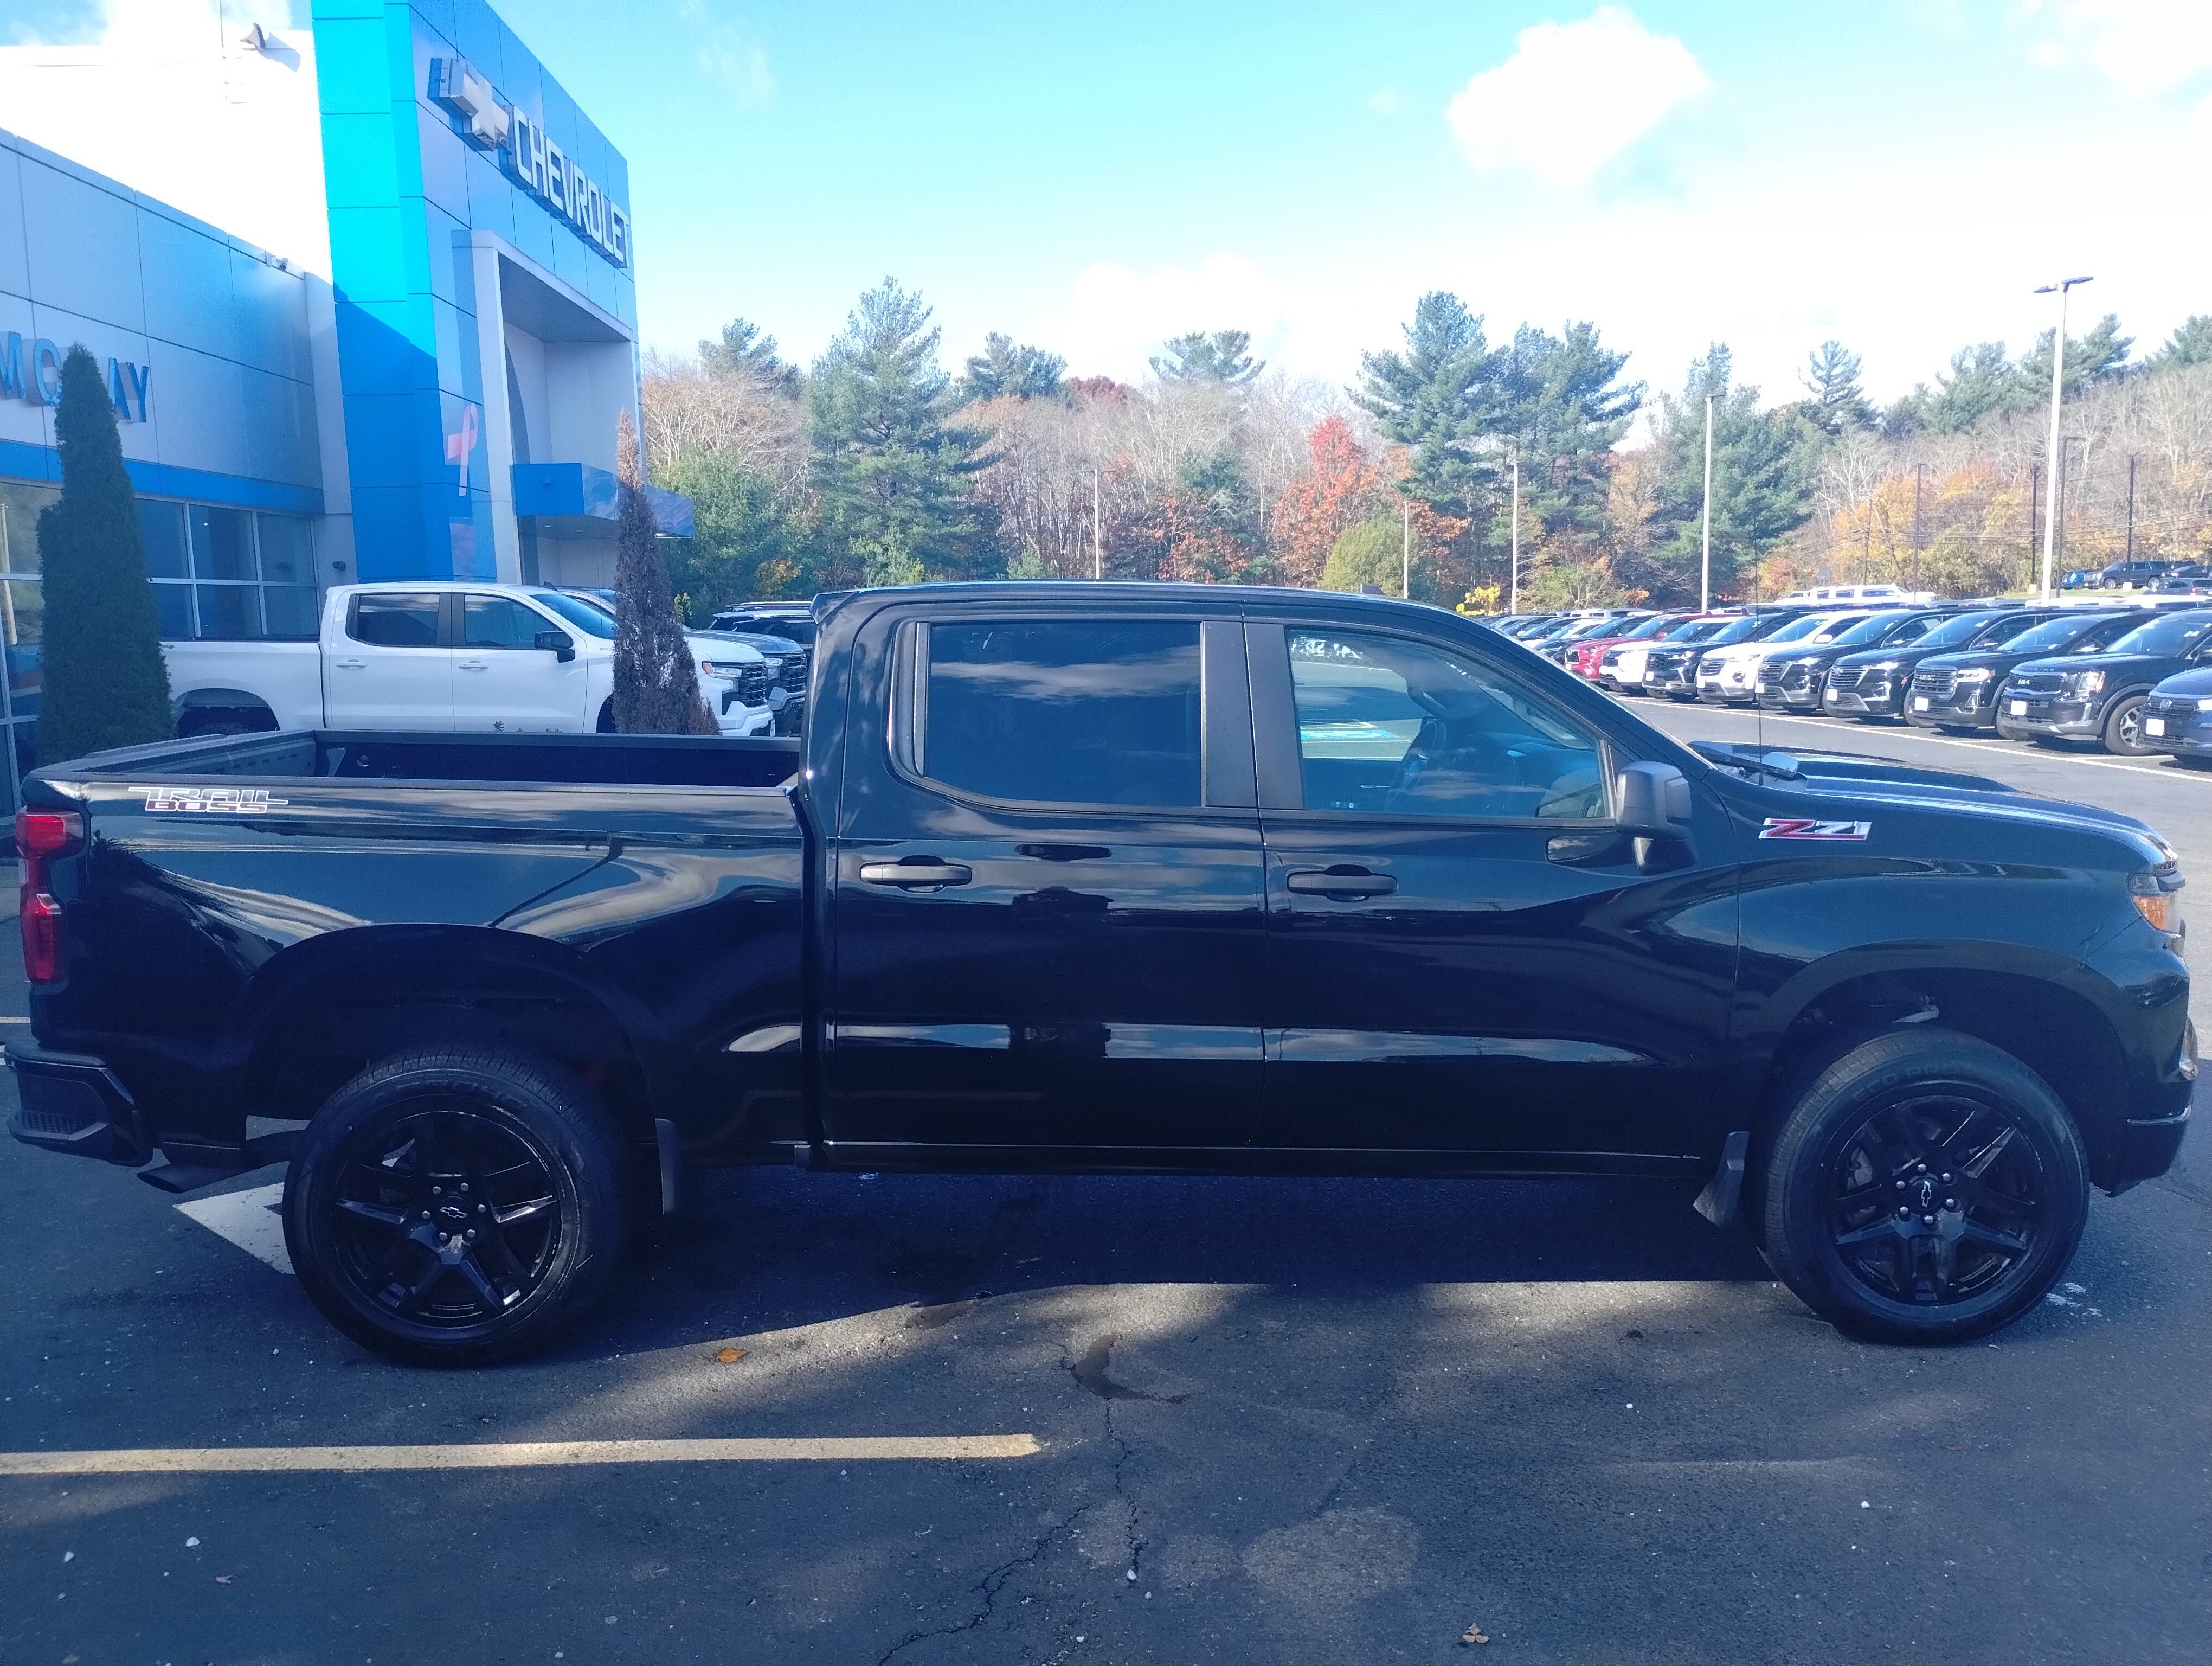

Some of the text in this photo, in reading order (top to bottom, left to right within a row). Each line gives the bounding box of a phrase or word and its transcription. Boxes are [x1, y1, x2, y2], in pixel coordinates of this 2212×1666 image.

[513, 105, 629, 268] CHEVROLET
[0, 331, 149, 422] MCAY
[128, 786, 288, 805] TRAIL
[145, 799, 268, 813] BOSS
[1758, 818, 1872, 841] Z71
